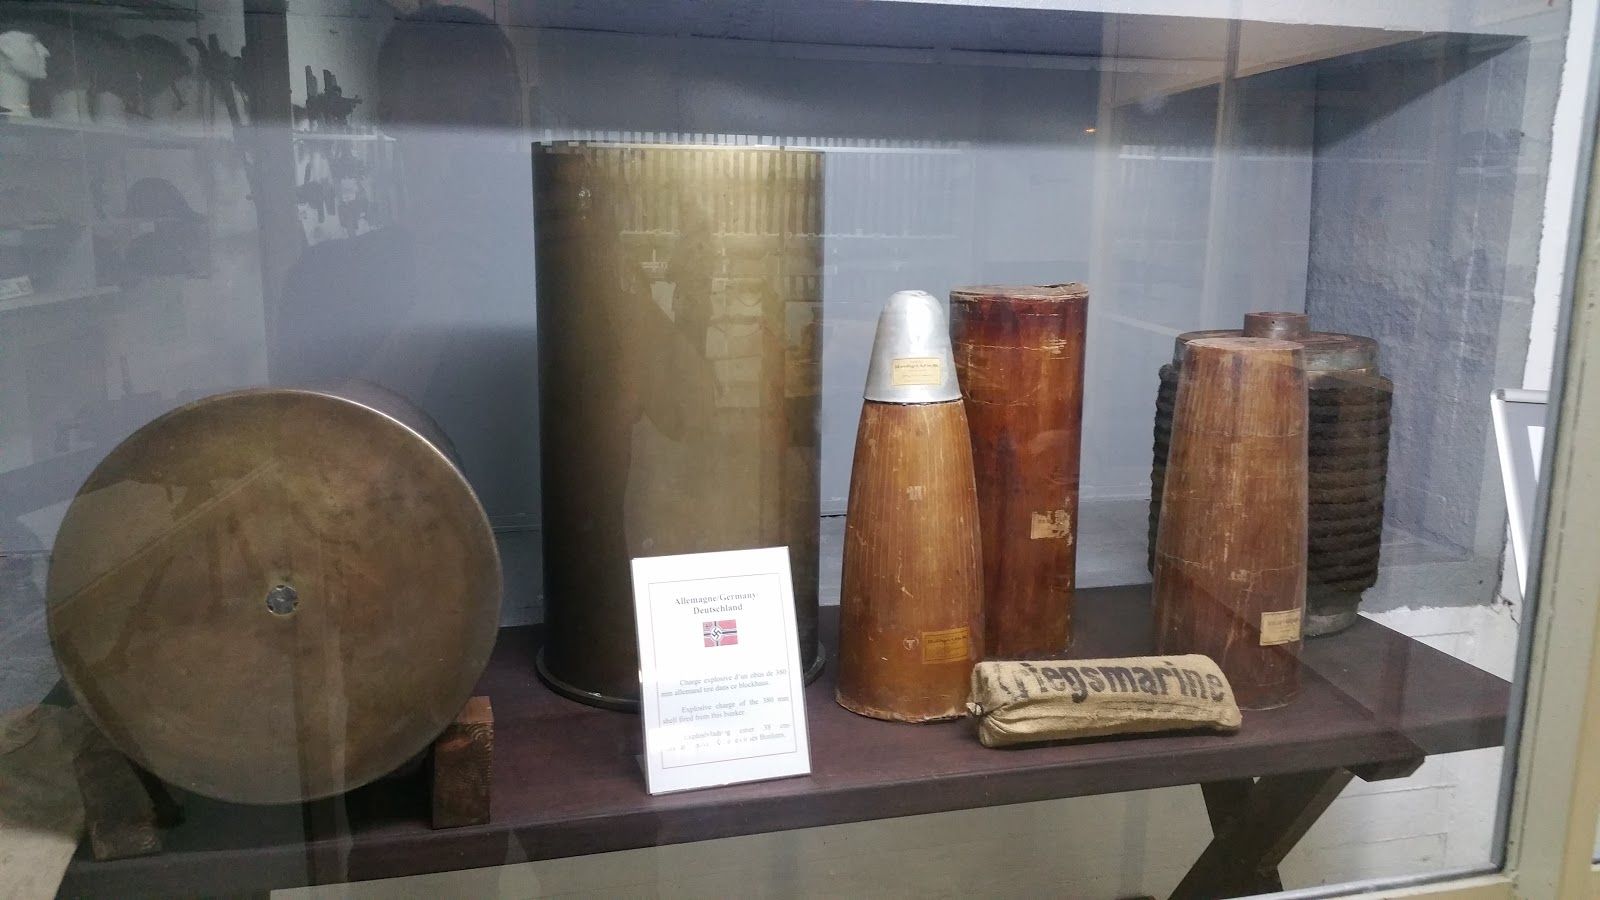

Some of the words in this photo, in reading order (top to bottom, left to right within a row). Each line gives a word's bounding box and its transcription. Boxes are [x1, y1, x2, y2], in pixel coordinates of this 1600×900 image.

[693, 603, 744, 615] Deutschland
[679, 677, 702, 687] Charge
[703, 675, 733, 685] explosive
[674, 686, 702, 696] allemand
[715, 684, 730, 692] dans
[681, 704, 713, 714] Explosive
[715, 702, 736, 712] charge
[749, 698, 760, 706] the
[679, 714, 694, 723] fired
[695, 713, 710, 722] from
